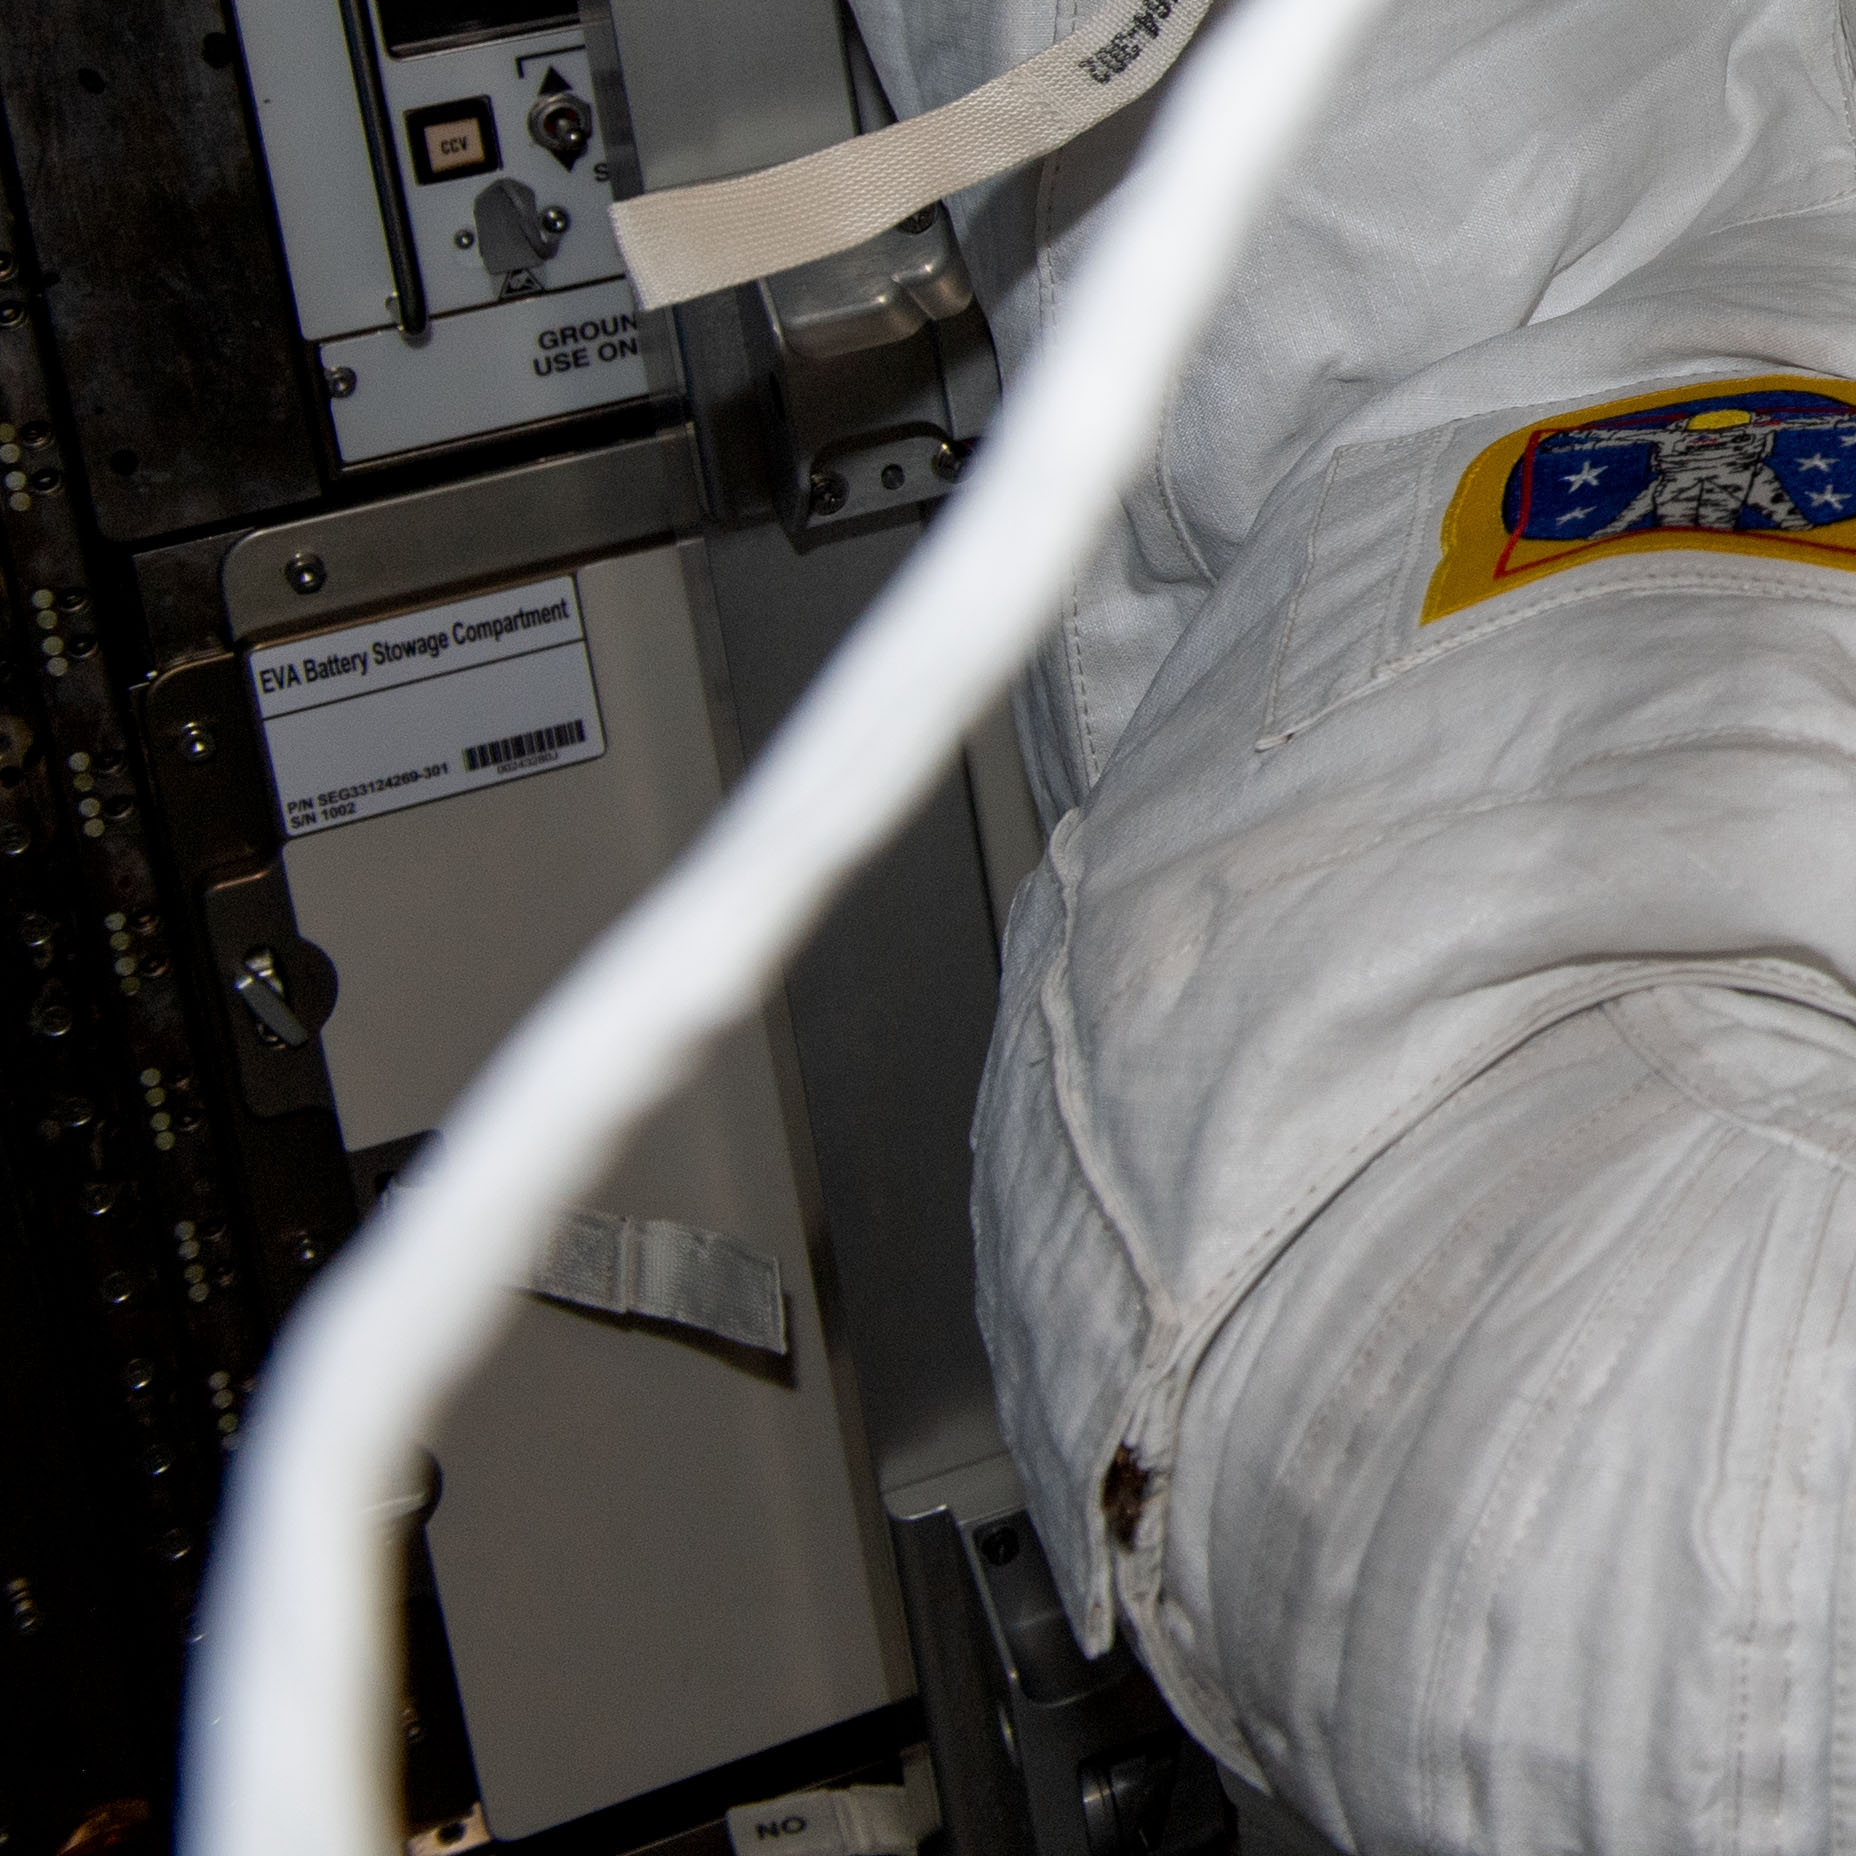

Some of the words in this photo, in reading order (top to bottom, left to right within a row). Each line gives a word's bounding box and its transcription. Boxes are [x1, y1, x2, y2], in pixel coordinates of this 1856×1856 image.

[537, 313, 639, 352] GROUN
[532, 347, 591, 378] USE
[596, 337, 639, 363] ON
[258, 666, 301, 695] EVA
[302, 650, 369, 685] Battery
[371, 630, 451, 667] Stowage
[452, 597, 571, 646] Compartment
[286, 799, 314, 816] P/N
[289, 813, 318, 831] S/N
[321, 801, 358, 822] 1002
